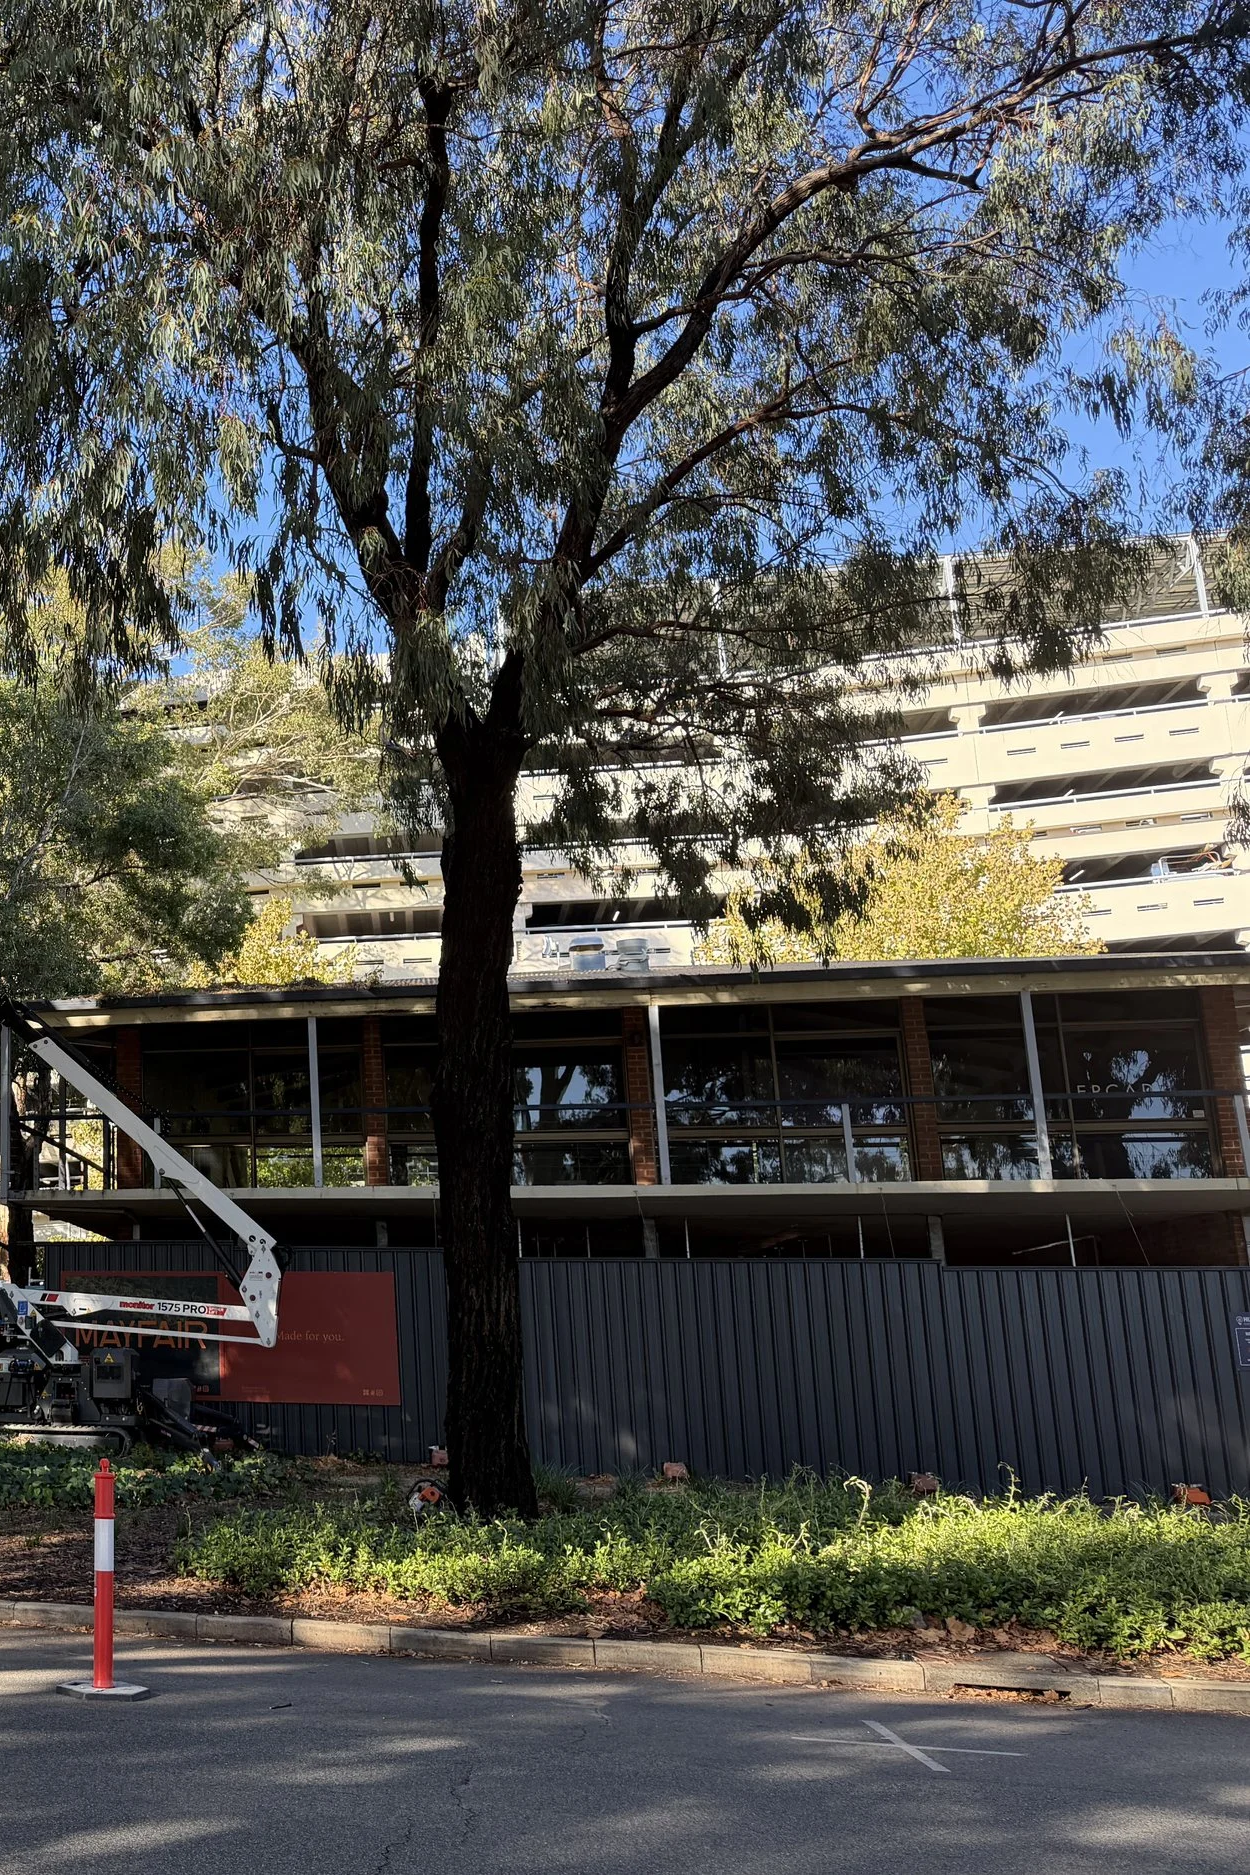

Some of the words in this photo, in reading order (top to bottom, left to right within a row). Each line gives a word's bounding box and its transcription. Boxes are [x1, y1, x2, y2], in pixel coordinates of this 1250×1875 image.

[119, 1300, 155, 1310] monitor
[157, 1302, 181, 1313] 1575
[182, 1304, 206, 1314] PRO
[75, 1319, 208, 1349] MAYFAIR
[305, 1330, 319, 1341] for
[322, 1332, 345, 1344] you.
